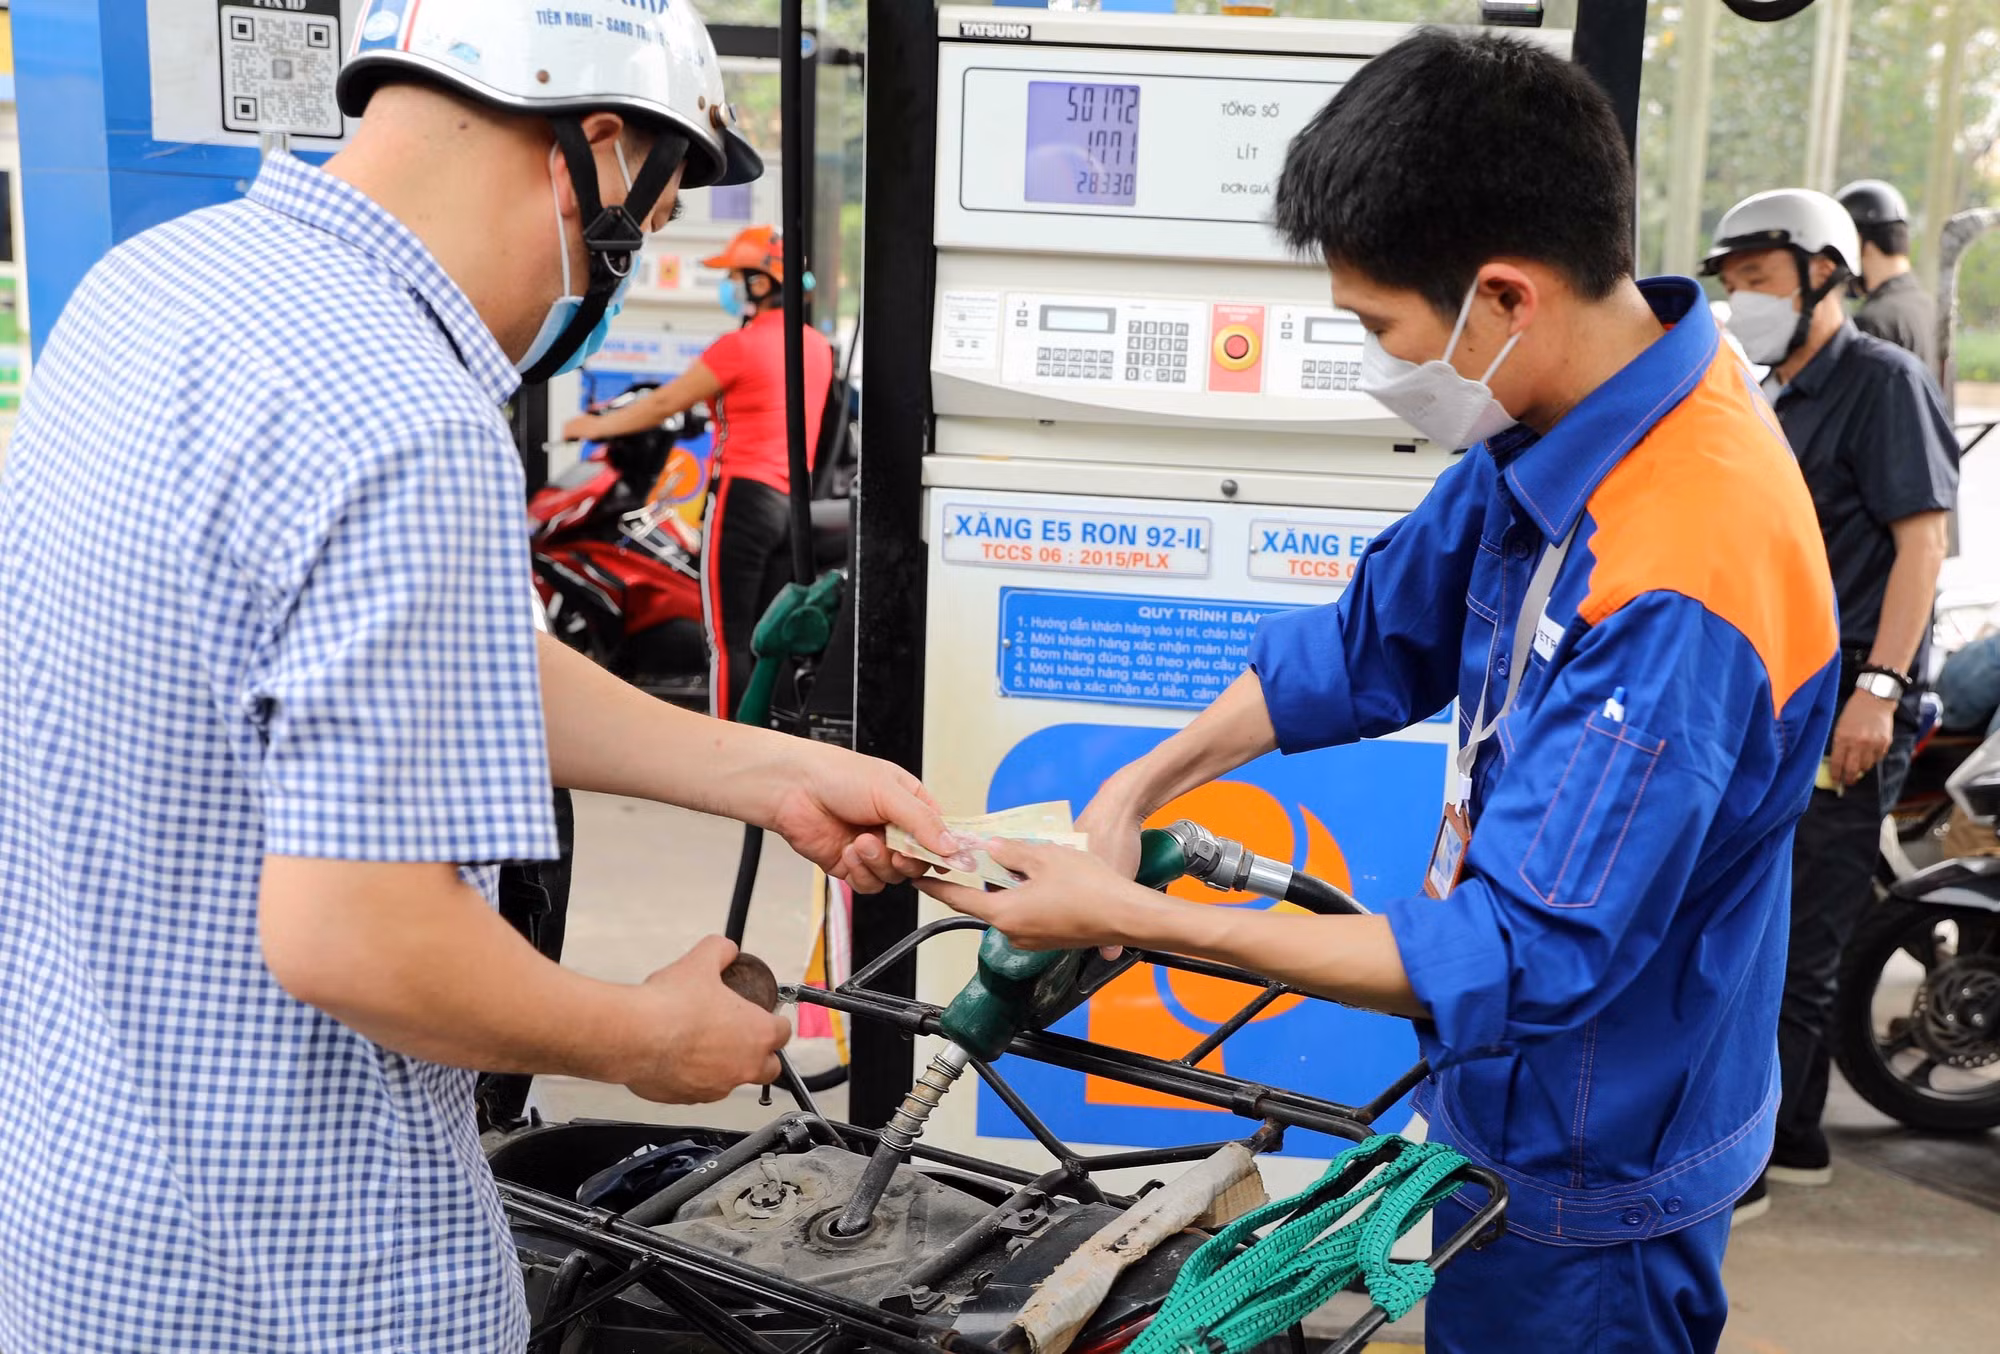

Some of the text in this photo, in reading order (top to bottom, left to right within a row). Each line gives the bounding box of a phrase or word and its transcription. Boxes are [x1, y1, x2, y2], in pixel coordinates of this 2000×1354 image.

[961, 23, 1029, 39] TATSUNO
[1066, 86, 1138, 124] 50172
[1237, 143, 1259, 161] LÍT
[1076, 172, 1133, 195] 28330
[1131, 321, 1140, 333] 7
[1129, 337, 1139, 348] 4
[1145, 338, 1155, 349] 5
[1144, 354, 1153, 365] 2
[1160, 355, 1168, 366] 3
[1127, 369, 1136, 379] 0
[955, 511, 1201, 549] XĂNG E5 RON 92-II
[1262, 528, 1373, 557] XĂNG E
[982, 543, 1032, 561] TCCS
[1040, 547, 1062, 563] 06
[1080, 550, 1169, 570] 2015/PLX
[1288, 560, 1339, 578] TCCS
[1138, 606, 1174, 620] QUY
[1178, 608, 1227, 622] TRÌNH
[1015, 631, 1027, 643] 2.
[1058, 634, 1095, 648] khách
[1099, 637, 1130, 652] hàng
[1133, 639, 1156, 652] xác
[1015, 646, 1027, 658] 3.
[1063, 649, 1095, 665] hàng
[1156, 656, 1184, 667] theo
[1187, 657, 1209, 671] yêu
[1014, 661, 1026, 673] 4.
[1057, 664, 1094, 677] khách
[1097, 667, 1129, 682] hàng
[1132, 669, 1154, 681] xác
[1014, 676, 1025, 688] 5.
[1065, 680, 1080, 690] và
[1084, 681, 1106, 692] xác
